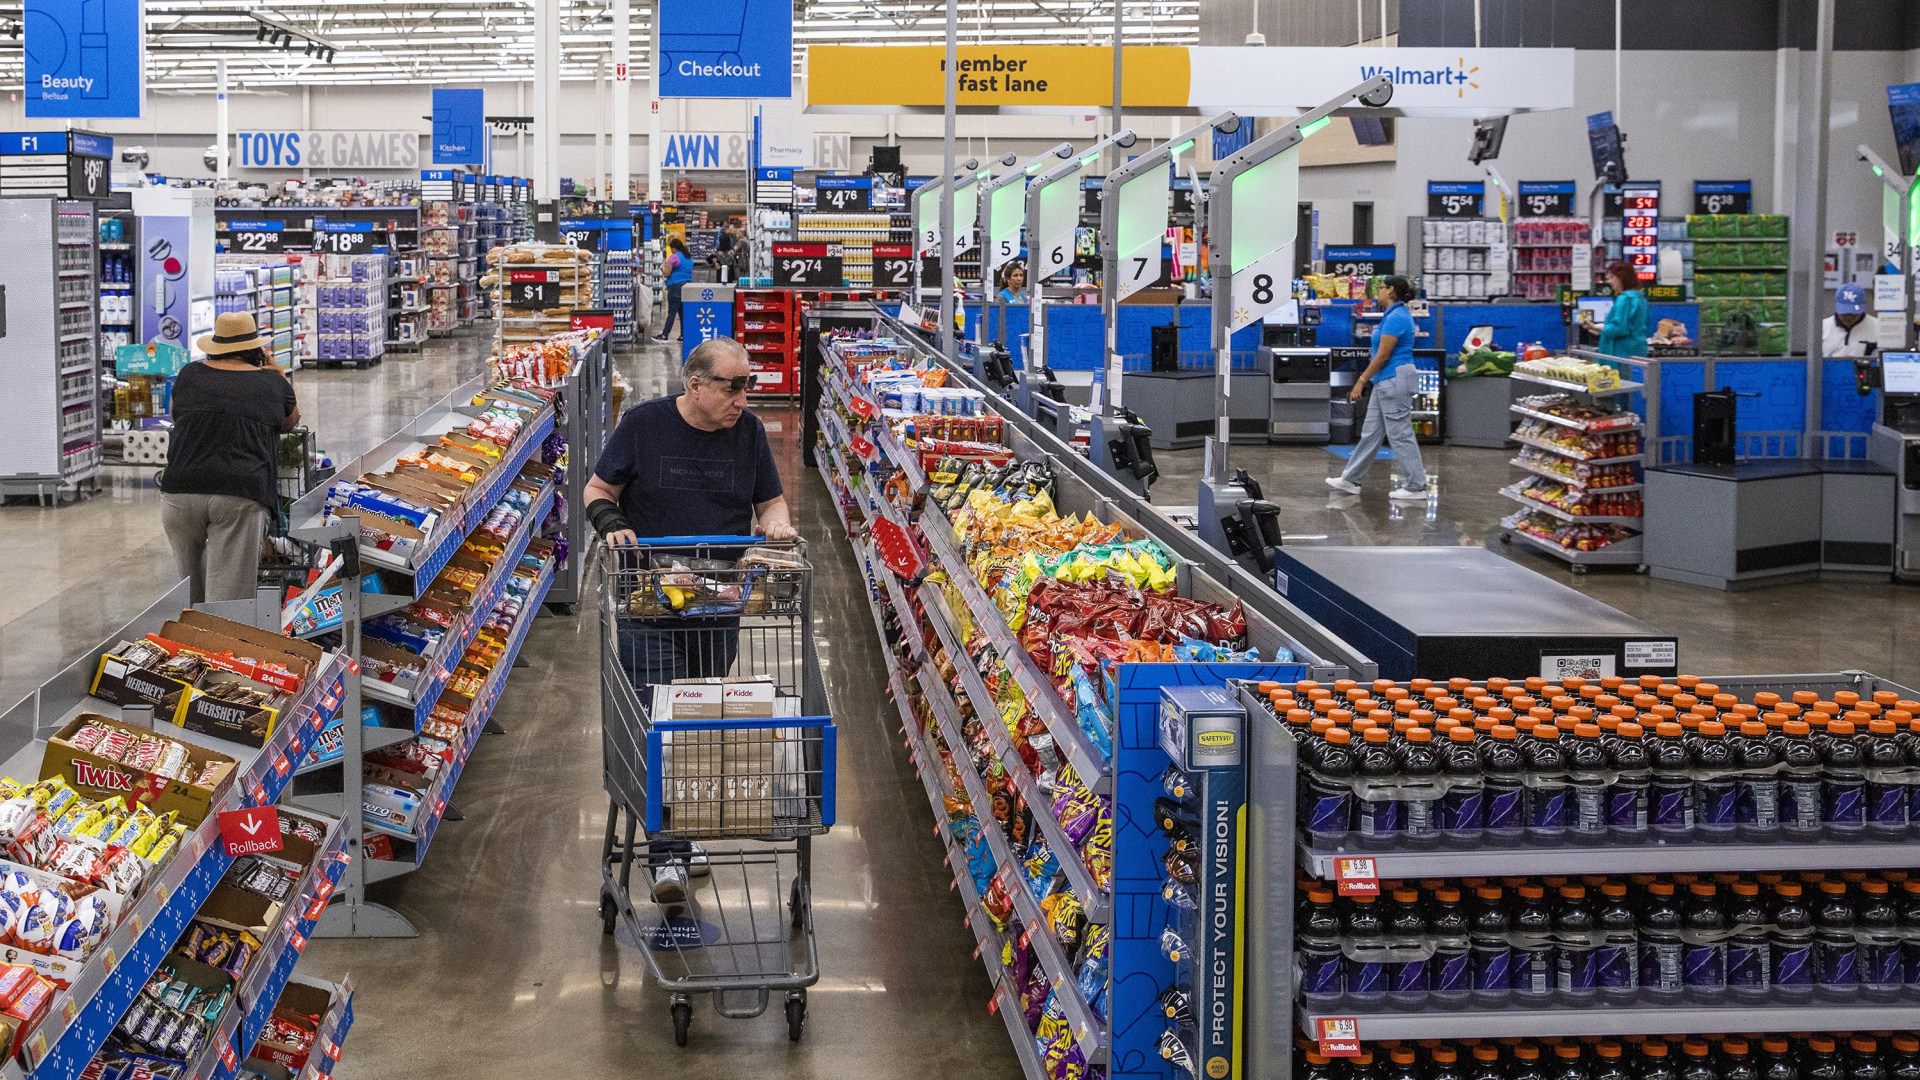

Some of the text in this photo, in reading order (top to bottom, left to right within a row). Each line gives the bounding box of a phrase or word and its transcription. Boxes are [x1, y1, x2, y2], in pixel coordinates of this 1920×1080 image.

[679, 60, 761, 77] Checkout
[42, 74, 94, 92] Beauty
[958, 73, 1049, 92] fast lane
[21, 136, 38, 151] F1
[238, 132, 417, 166] TOYS & GAMES
[439, 144, 466, 152] Kitchen
[661, 134, 745, 168] AWN &
[769, 146, 803, 155] Pharmacy
[766, 170, 778, 178] G1
[1636, 197, 1652, 208] 54
[1627, 216, 1652, 228] 203
[927, 230, 935, 243] 3
[956, 235, 967, 248] 4
[1631, 235, 1651, 246] 150
[1001, 241, 1011, 256] 5
[1051, 245, 1064, 264] 6
[1635, 254, 1651, 265] 27
[782, 259, 822, 283] $274
[1133, 257, 1149, 281] 7
[524, 284, 543, 301] $1
[1252, 273, 1274, 305] 8
[1340, 350, 1372, 358] Cart Her
[261, 674, 273, 684] 24
[125, 676, 165, 700] HERSHEY'S
[683, 690, 703, 698] Kidde
[733, 689, 753, 697] Kidde
[196, 700, 246, 723] HERSHEY'S
[172, 785, 188, 797] 24
[229, 837, 279, 856] Rollback
[1348, 882, 1377, 890] Rollback
[1212, 800, 1229, 1045] PROTECT YOUR VISION!
[643, 932, 700, 940] Checkou
[1330, 1043, 1358, 1051] Rollback
[272, 1051, 294, 1063] SHARE
